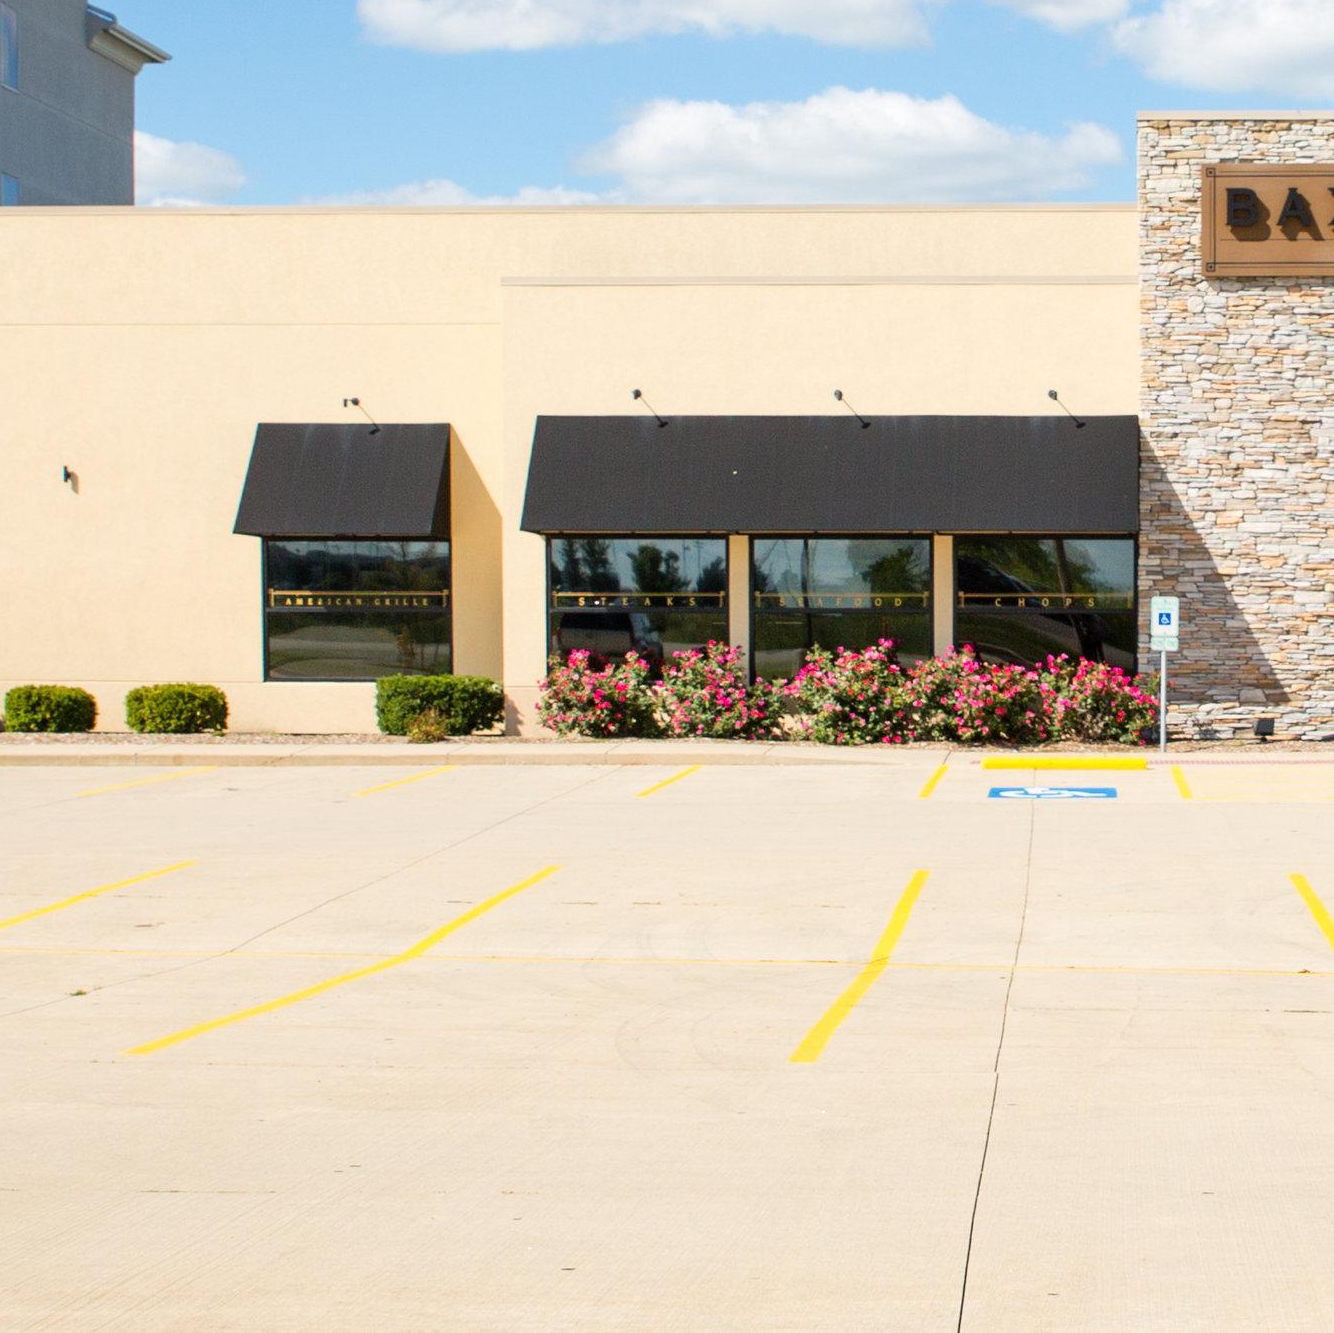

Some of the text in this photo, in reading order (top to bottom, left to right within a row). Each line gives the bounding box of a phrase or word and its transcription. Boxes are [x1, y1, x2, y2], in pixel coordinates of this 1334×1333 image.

[284, 597, 428, 606] AMERICAN GRILLE
[578, 597, 696, 607] STEAKS
[779, 597, 903, 607] SEAFOOD
[994, 597, 1095, 608] CHOPS
